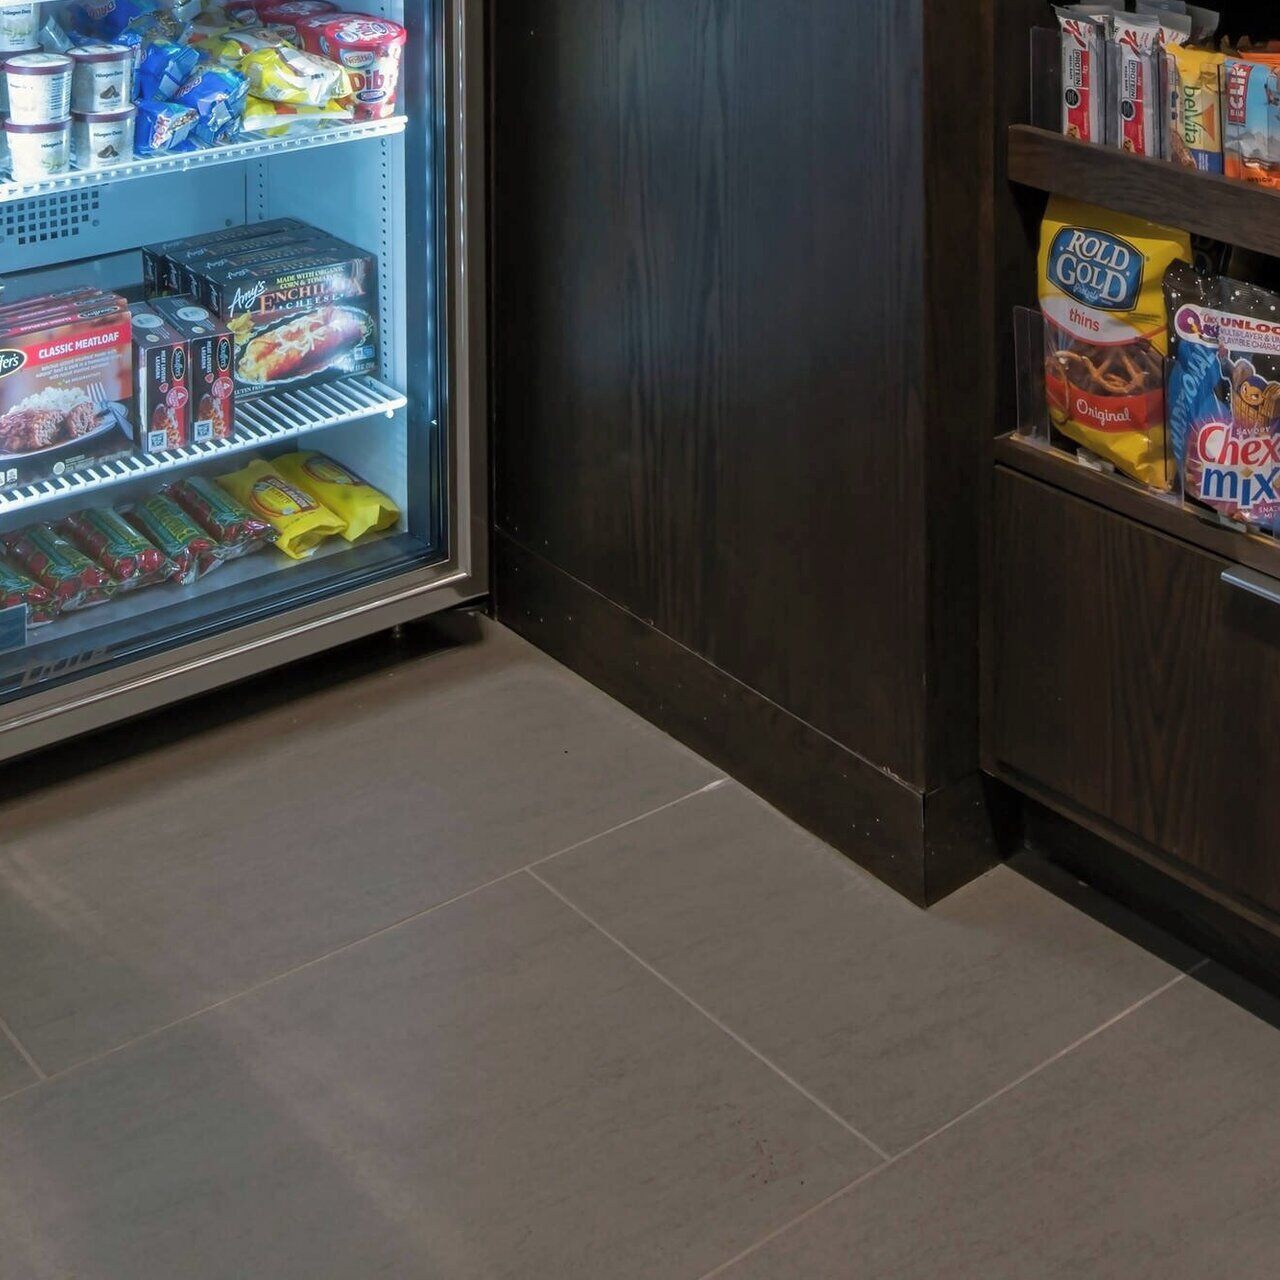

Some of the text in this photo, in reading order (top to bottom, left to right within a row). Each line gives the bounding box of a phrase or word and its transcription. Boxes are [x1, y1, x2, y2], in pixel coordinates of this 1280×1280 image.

[1073, 49, 1081, 87] PROTEIN
[1183, 85, 1202, 150] belVita
[1067, 230, 1132, 271] ROLD
[276, 272, 314, 284] MADE WITH
[279, 281, 299, 289] CORN
[1056, 254, 1127, 303] GOLD
[228, 281, 267, 317] Amy's
[1069, 308, 1100, 333] thins
[39, 332, 120, 360] CLASSIC MEATLOAF
[1076, 399, 1132, 426] Original
